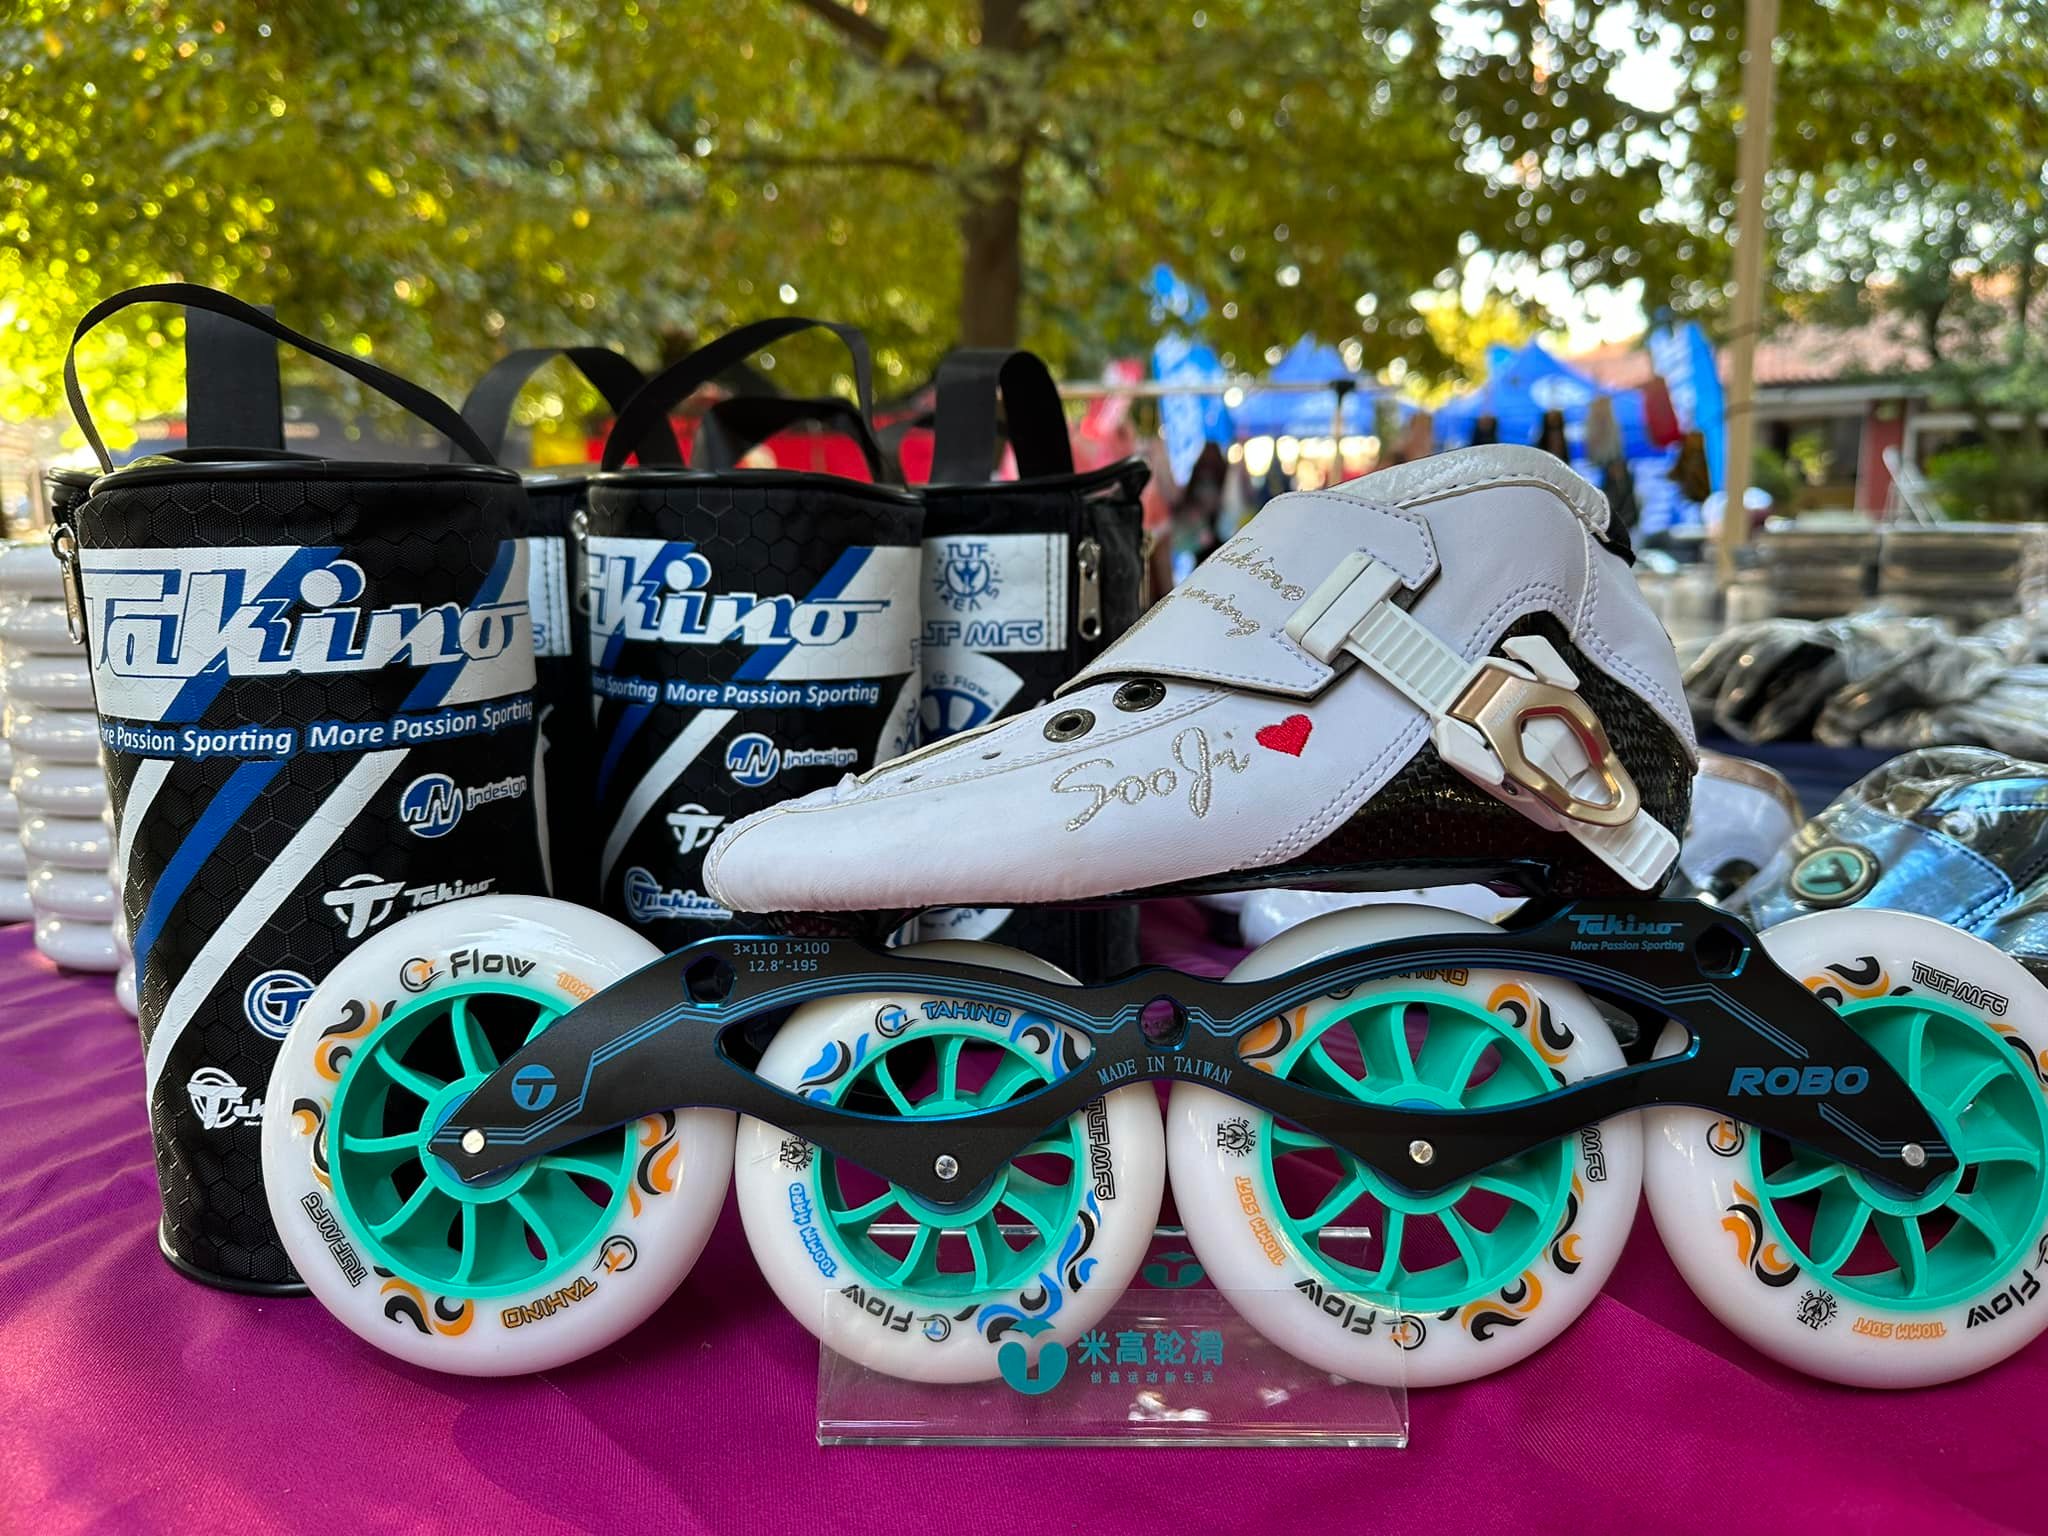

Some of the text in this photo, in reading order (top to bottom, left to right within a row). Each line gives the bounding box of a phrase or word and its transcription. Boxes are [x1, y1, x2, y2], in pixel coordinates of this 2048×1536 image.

[666, 683, 717, 702] More
[723, 685, 801, 704] Passion
[806, 683, 880, 707] Sporting
[117, 726, 175, 750] Passion
[183, 730, 292, 755] Sporting
[310, 725, 384, 747] More
[392, 713, 477, 741] Passion
[482, 698, 534, 731] Sporting
[783, 748, 858, 769] jndesign
[466, 775, 528, 811] jndesign
[404, 878, 496, 907] Takino
[1568, 914, 1683, 935] Takino
[1571, 940, 1685, 952] More Passion Sporting
[450, 948, 536, 979] Flow
[1096, 1056, 1233, 1086] MADE IN TAIWAN
[1728, 1066, 1870, 1097] ROBO
[840, 1284, 915, 1333] Flow
[1294, 1278, 1377, 1336] Flow
[1966, 1268, 2041, 1329] Flow
[1078, 1328, 1225, 1367] 米高轮滑
